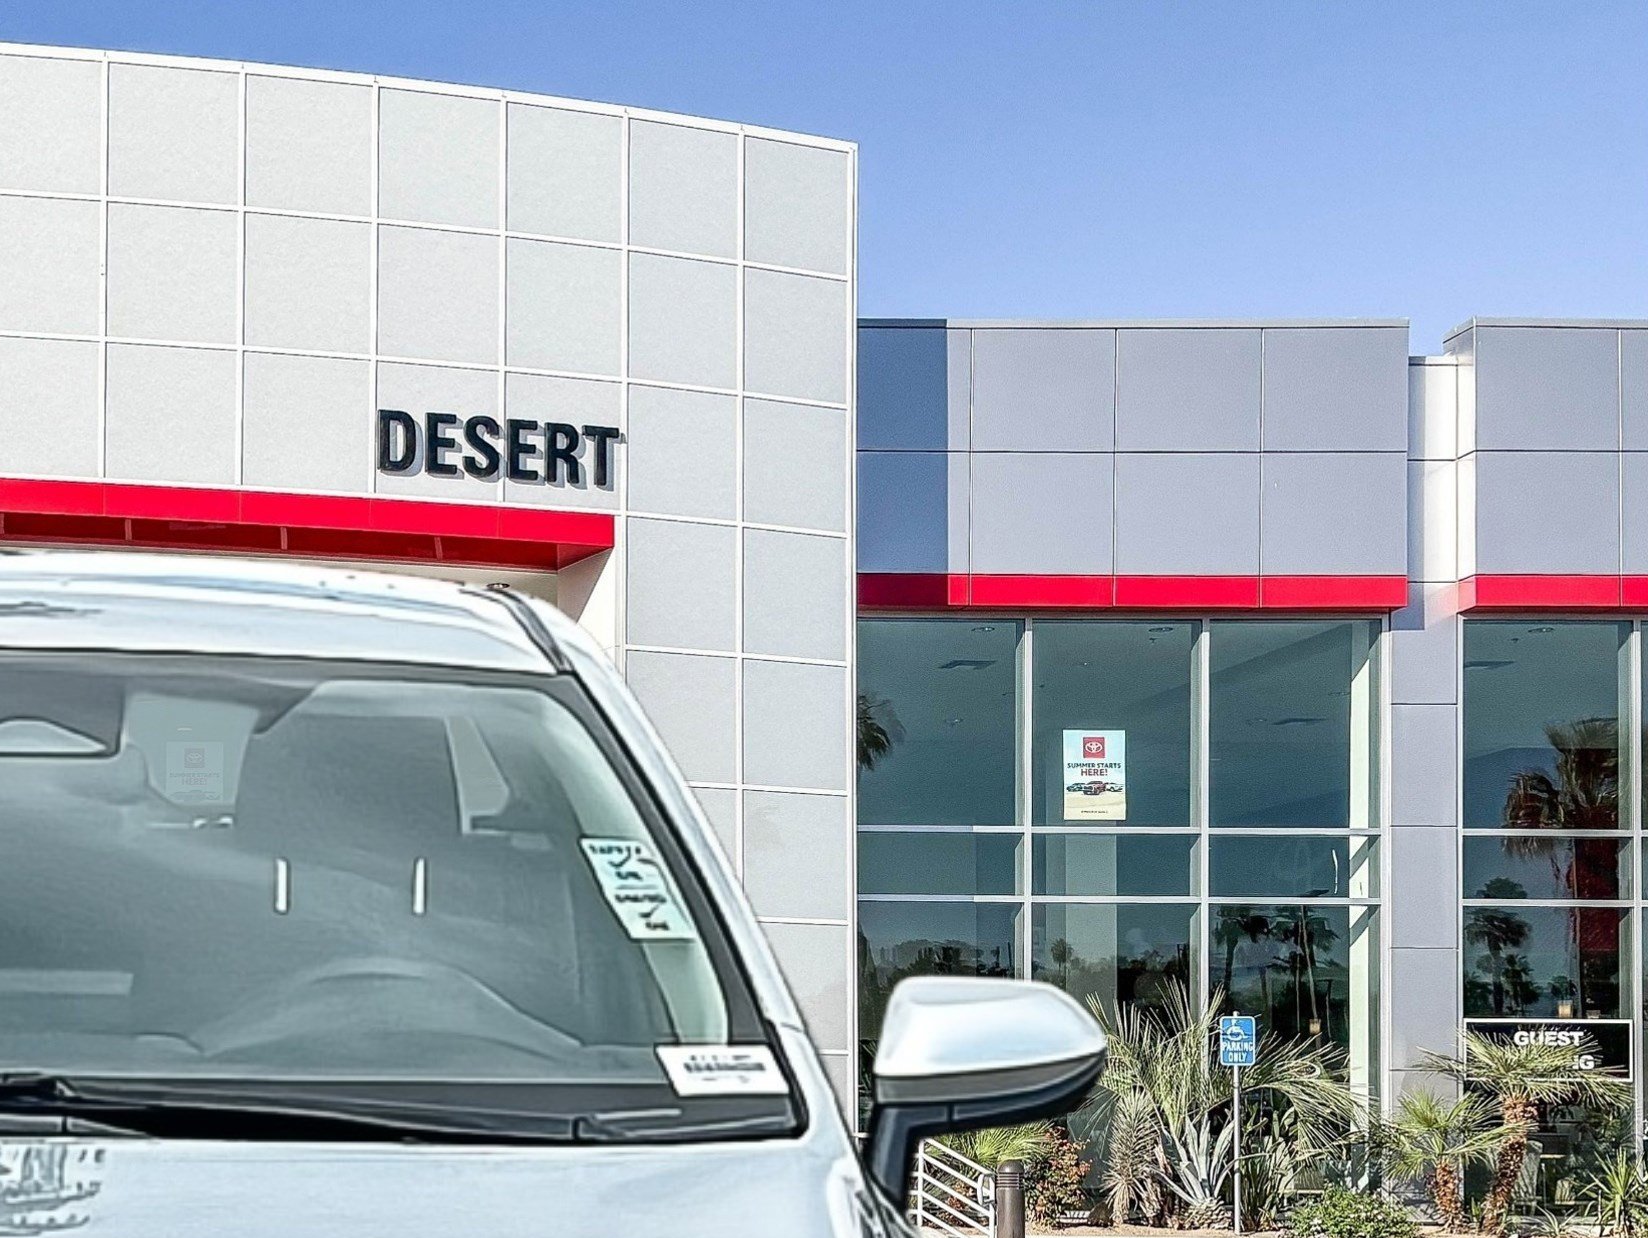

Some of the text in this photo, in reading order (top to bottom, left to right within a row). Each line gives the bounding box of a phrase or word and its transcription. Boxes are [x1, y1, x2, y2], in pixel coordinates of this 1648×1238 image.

[377, 409, 620, 487] DESERT
[1513, 1030, 1584, 1047] GUEST
[1222, 1041, 1253, 1051] PARKING
[1228, 1052, 1247, 1062] ONLY
